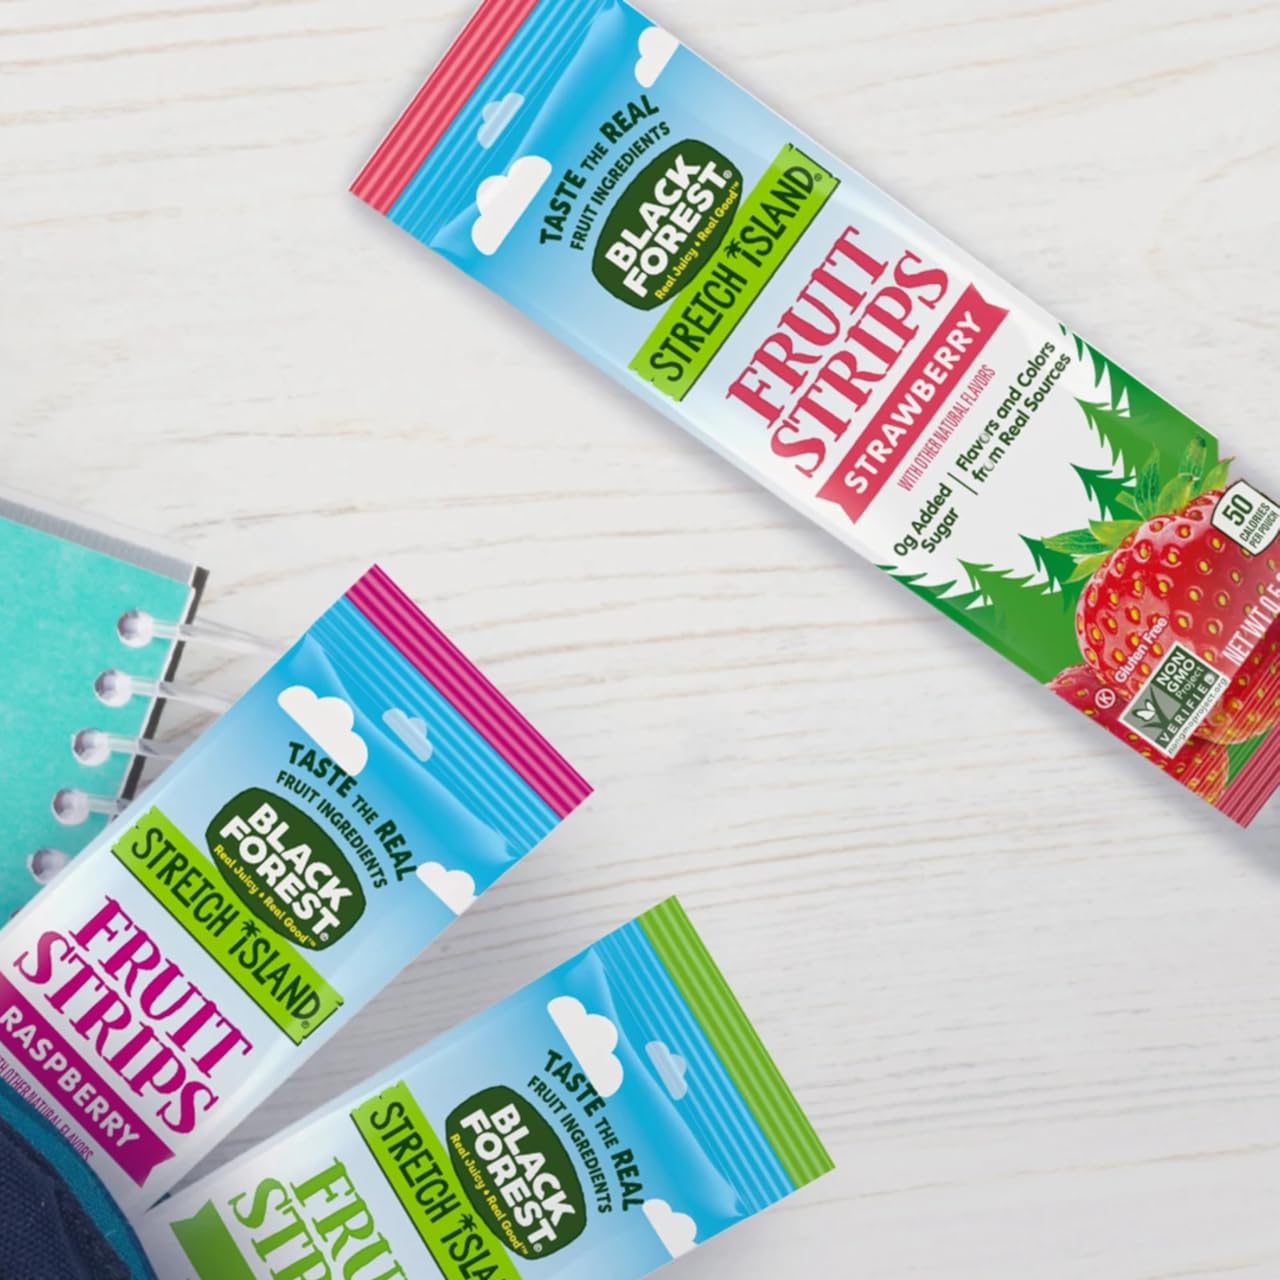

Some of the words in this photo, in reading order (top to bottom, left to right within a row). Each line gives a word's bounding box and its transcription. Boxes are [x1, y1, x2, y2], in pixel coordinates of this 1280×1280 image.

[541, 168, 587, 243] TASTE
[580, 142, 608, 171] THE
[599, 94, 659, 144] REAL
[570, 204, 593, 250] FRUIT
[591, 120, 671, 204] INGREDIENTS
[603, 153, 702, 272] BLACK
[654, 275, 675, 300] Real
[671, 246, 698, 279] Juicy
[696, 216, 718, 241] Real
[649, 262, 748, 382] STRETCH
[725, 224, 890, 429] FRUIT
[770, 249, 948, 477] STRIPS
[843, 310, 982, 493] STRAWBERRY
[897, 462, 923, 491] WITH
[913, 436, 942, 469] OTHER
[932, 399, 969, 443] NATURAL
[959, 363, 996, 406] FLAVORS
[996, 385, 1022, 419] and
[1017, 341, 1055, 388] Colors
[998, 408, 1030, 446] Real
[1024, 352, 1071, 411] Sources
[911, 481, 953, 535] Added
[920, 506, 959, 554] Sugar
[1221, 492, 1254, 527] 50
[1239, 502, 1270, 542] CALORIES
[1113, 642, 1148, 684] Gluten
[1142, 617, 1168, 644] Free
[1155, 650, 1185, 686] NON
[1165, 657, 1196, 694] GMO
[1175, 664, 1203, 699] Project
[1220, 630, 1255, 667] NET
[1240, 605, 1274, 640] WT
[246, 801, 353, 913] BLACK
[275, 770, 320, 799] FRUIT
[317, 799, 388, 889] INGREDIENTS
[289, 742, 357, 798] TASTE
[351, 794, 378, 825] THE
[373, 819, 417, 881] REAL
[130, 827, 240, 938] STRETCH
[213, 844, 236, 867] Real
[230, 864, 260, 894] Juicy
[262, 895, 286, 919] Real
[13, 932, 219, 1134] STRIPS
[68, 895, 253, 1079] FRUIT
[369, 1102, 461, 1223] STRETCH
[449, 1132, 469, 1158] Real
[462, 1157, 486, 1189] Juicy
[485, 1194, 506, 1220] Real
[489, 1102, 575, 1227] BLACK
[526, 1075, 566, 1110] FRUIT
[560, 1113, 612, 1214] INGREDIENTS
[544, 1050, 606, 1117] TASTE
[594, 1116, 618, 1149] THE
[610, 1148, 643, 1211] REAL
